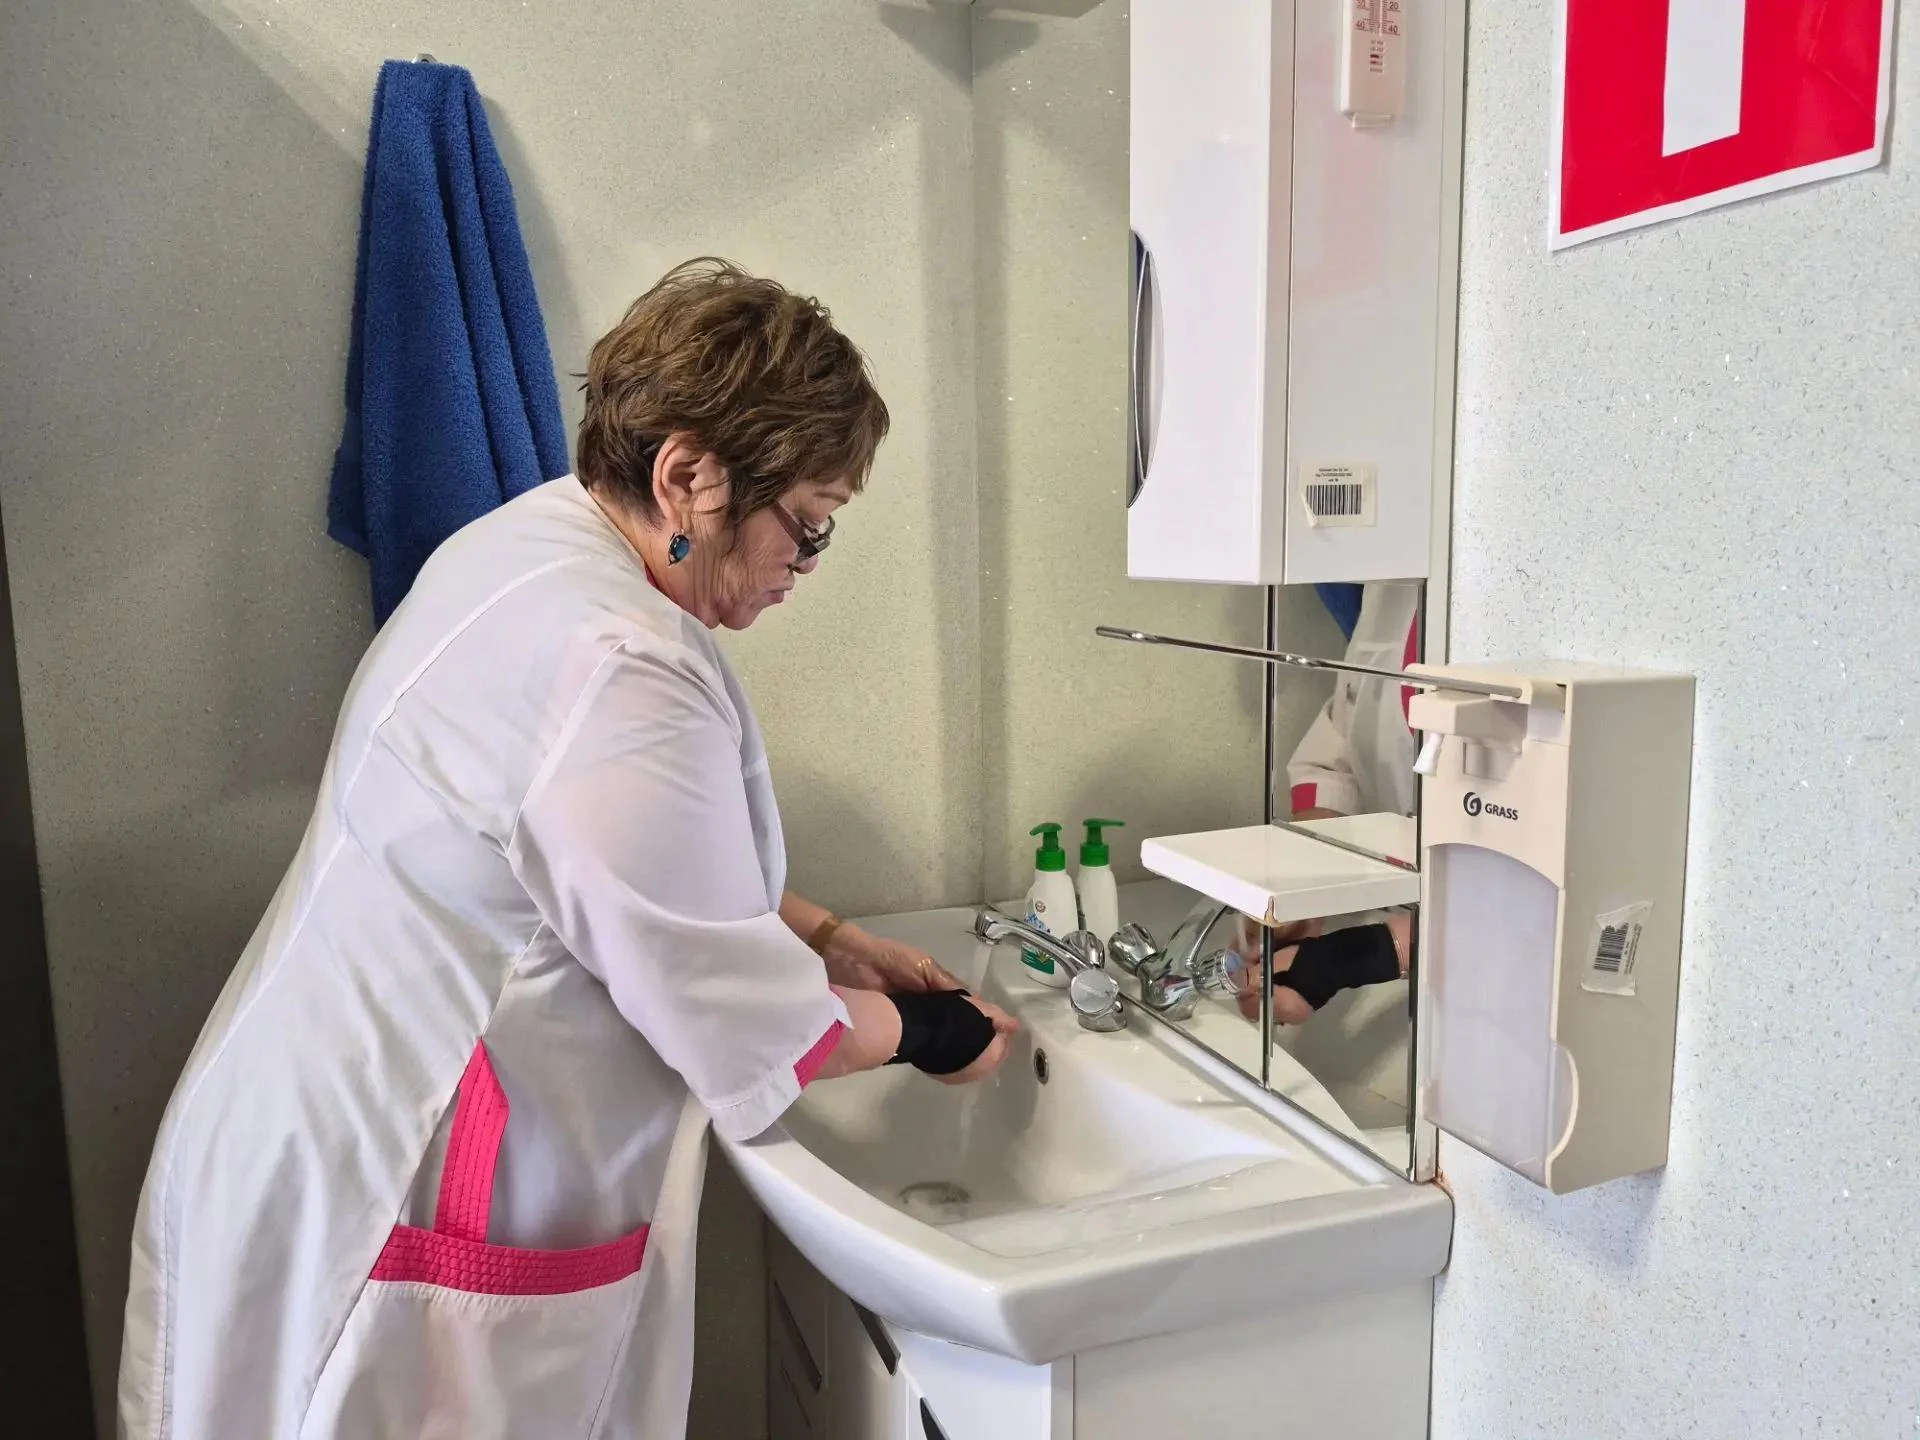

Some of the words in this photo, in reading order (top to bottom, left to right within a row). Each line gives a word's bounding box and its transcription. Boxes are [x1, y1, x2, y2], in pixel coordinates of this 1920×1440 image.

[1389, 1, 1399, 10] 20
[1388, 25, 1399, 34] 40
[1485, 803, 1519, 821] GRASS
